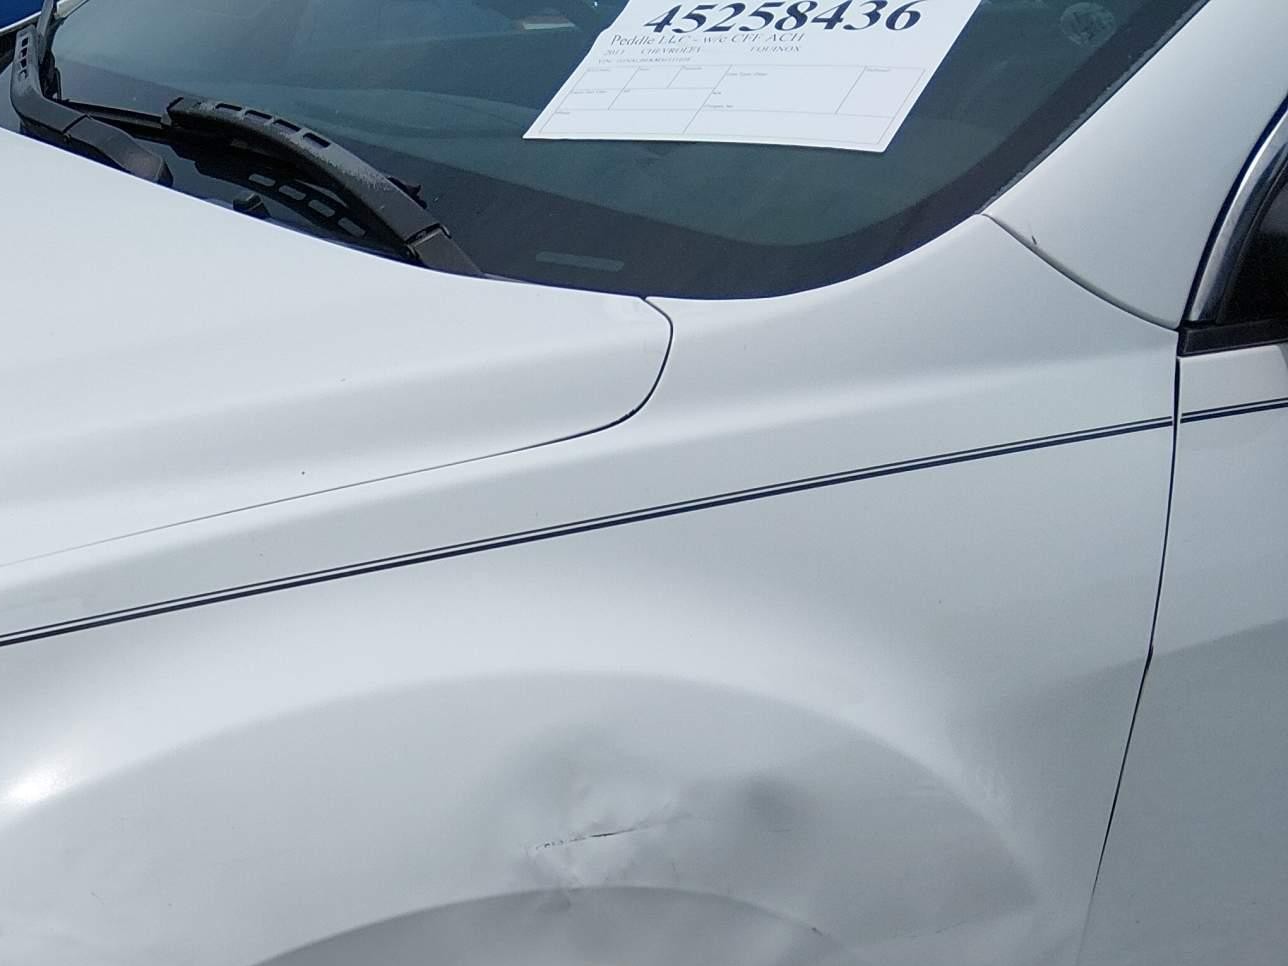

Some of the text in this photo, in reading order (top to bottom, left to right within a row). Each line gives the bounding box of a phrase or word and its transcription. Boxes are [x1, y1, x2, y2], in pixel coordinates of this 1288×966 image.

[643, 0, 929, 34] 45258436
[610, 34, 655, 46] Peddle
[658, 34, 690, 45] LLC
[640, 46, 702, 55] CHEVROLET
